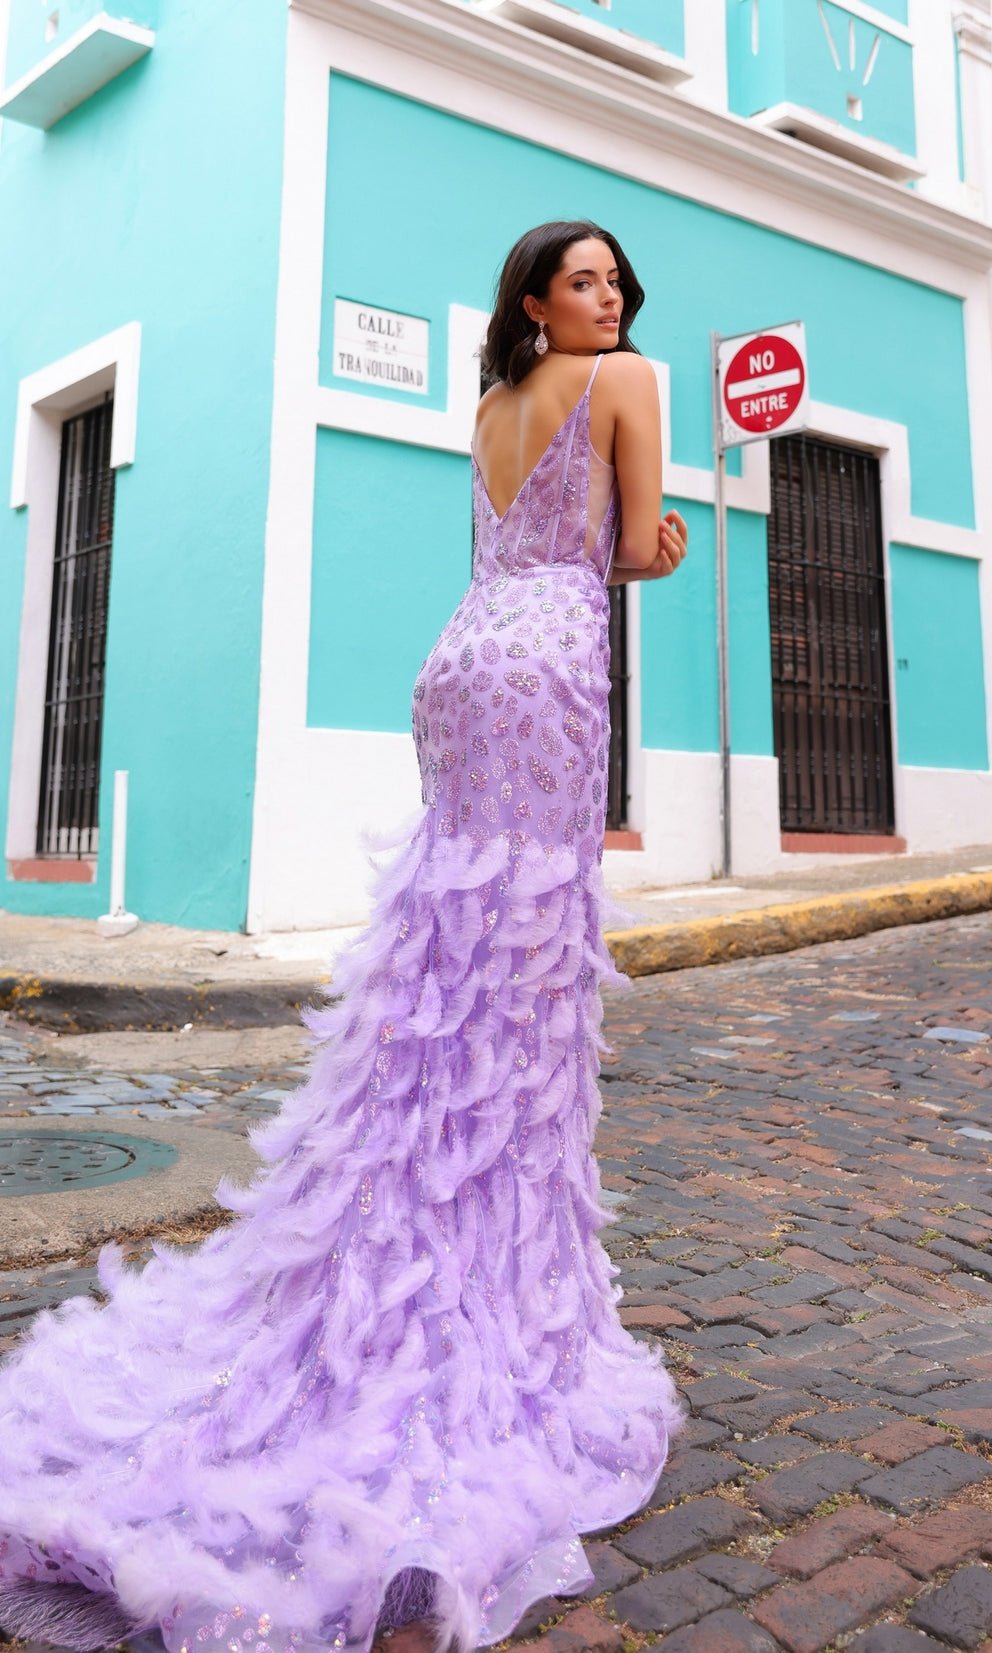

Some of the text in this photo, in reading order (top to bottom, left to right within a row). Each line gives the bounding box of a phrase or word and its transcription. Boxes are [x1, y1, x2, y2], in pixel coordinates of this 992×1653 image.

[358, 313, 404, 338] CALLE
[749, 350, 775, 375] NO
[740, 392, 788, 418] ENTRE
